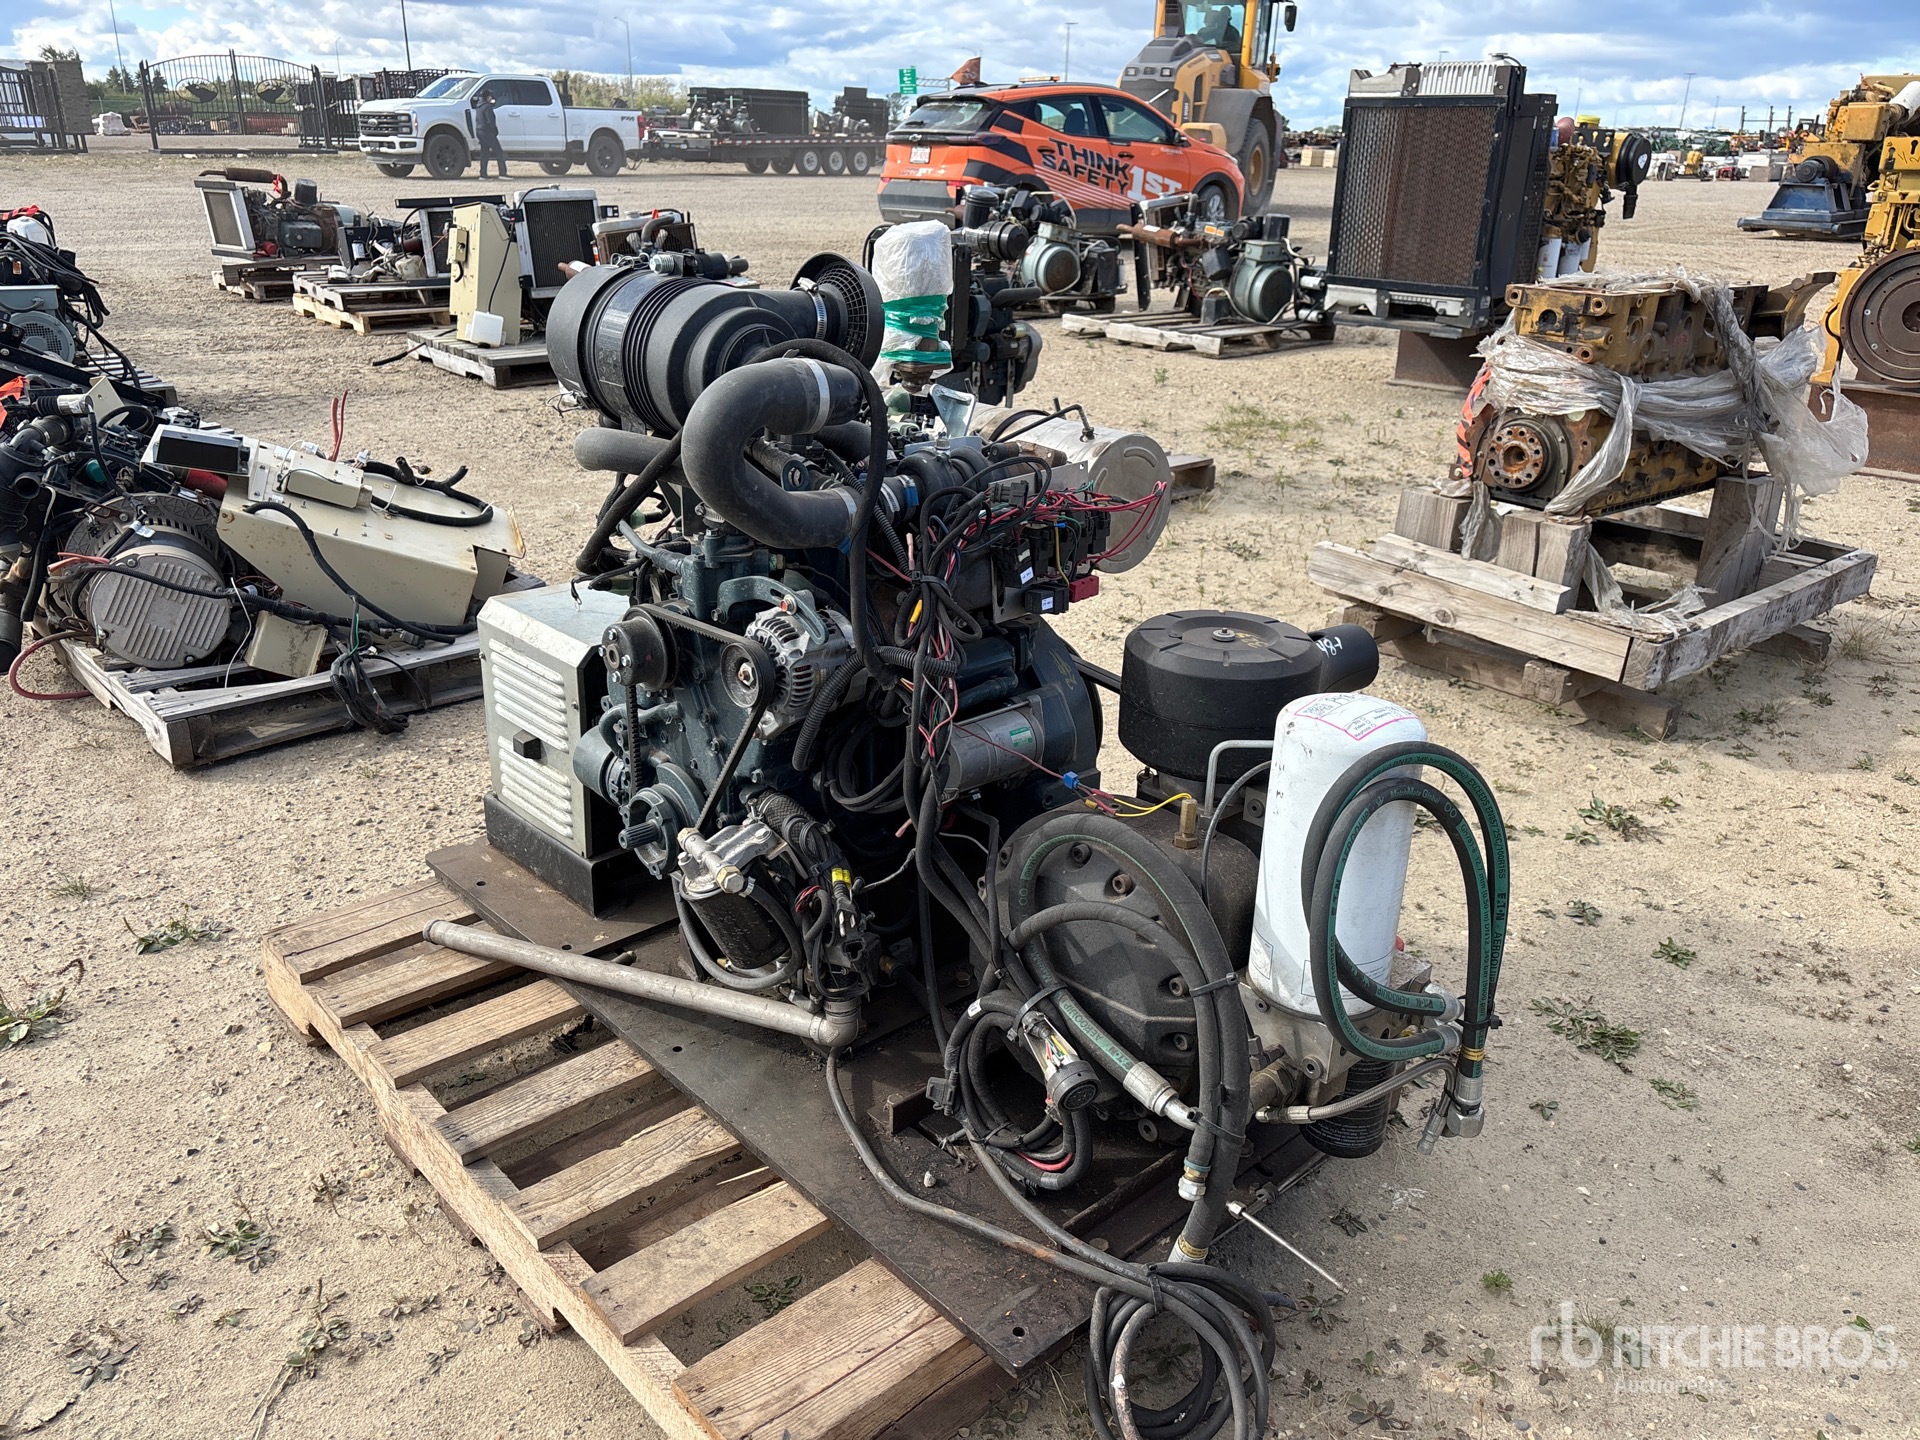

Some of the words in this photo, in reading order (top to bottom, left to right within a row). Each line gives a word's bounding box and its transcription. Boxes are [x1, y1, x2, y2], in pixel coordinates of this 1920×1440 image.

[1042, 153, 1129, 195] SAFETY
[1049, 137, 1130, 180] THINK
[1126, 165, 1183, 201] 1ST
[1466, 776, 1490, 807] EXCEEDS
[1486, 931, 1502, 983] AEROQUIP
[1374, 985, 1410, 1007] AEROQUIP
[1061, 999, 1103, 1044] AEROQUIP
